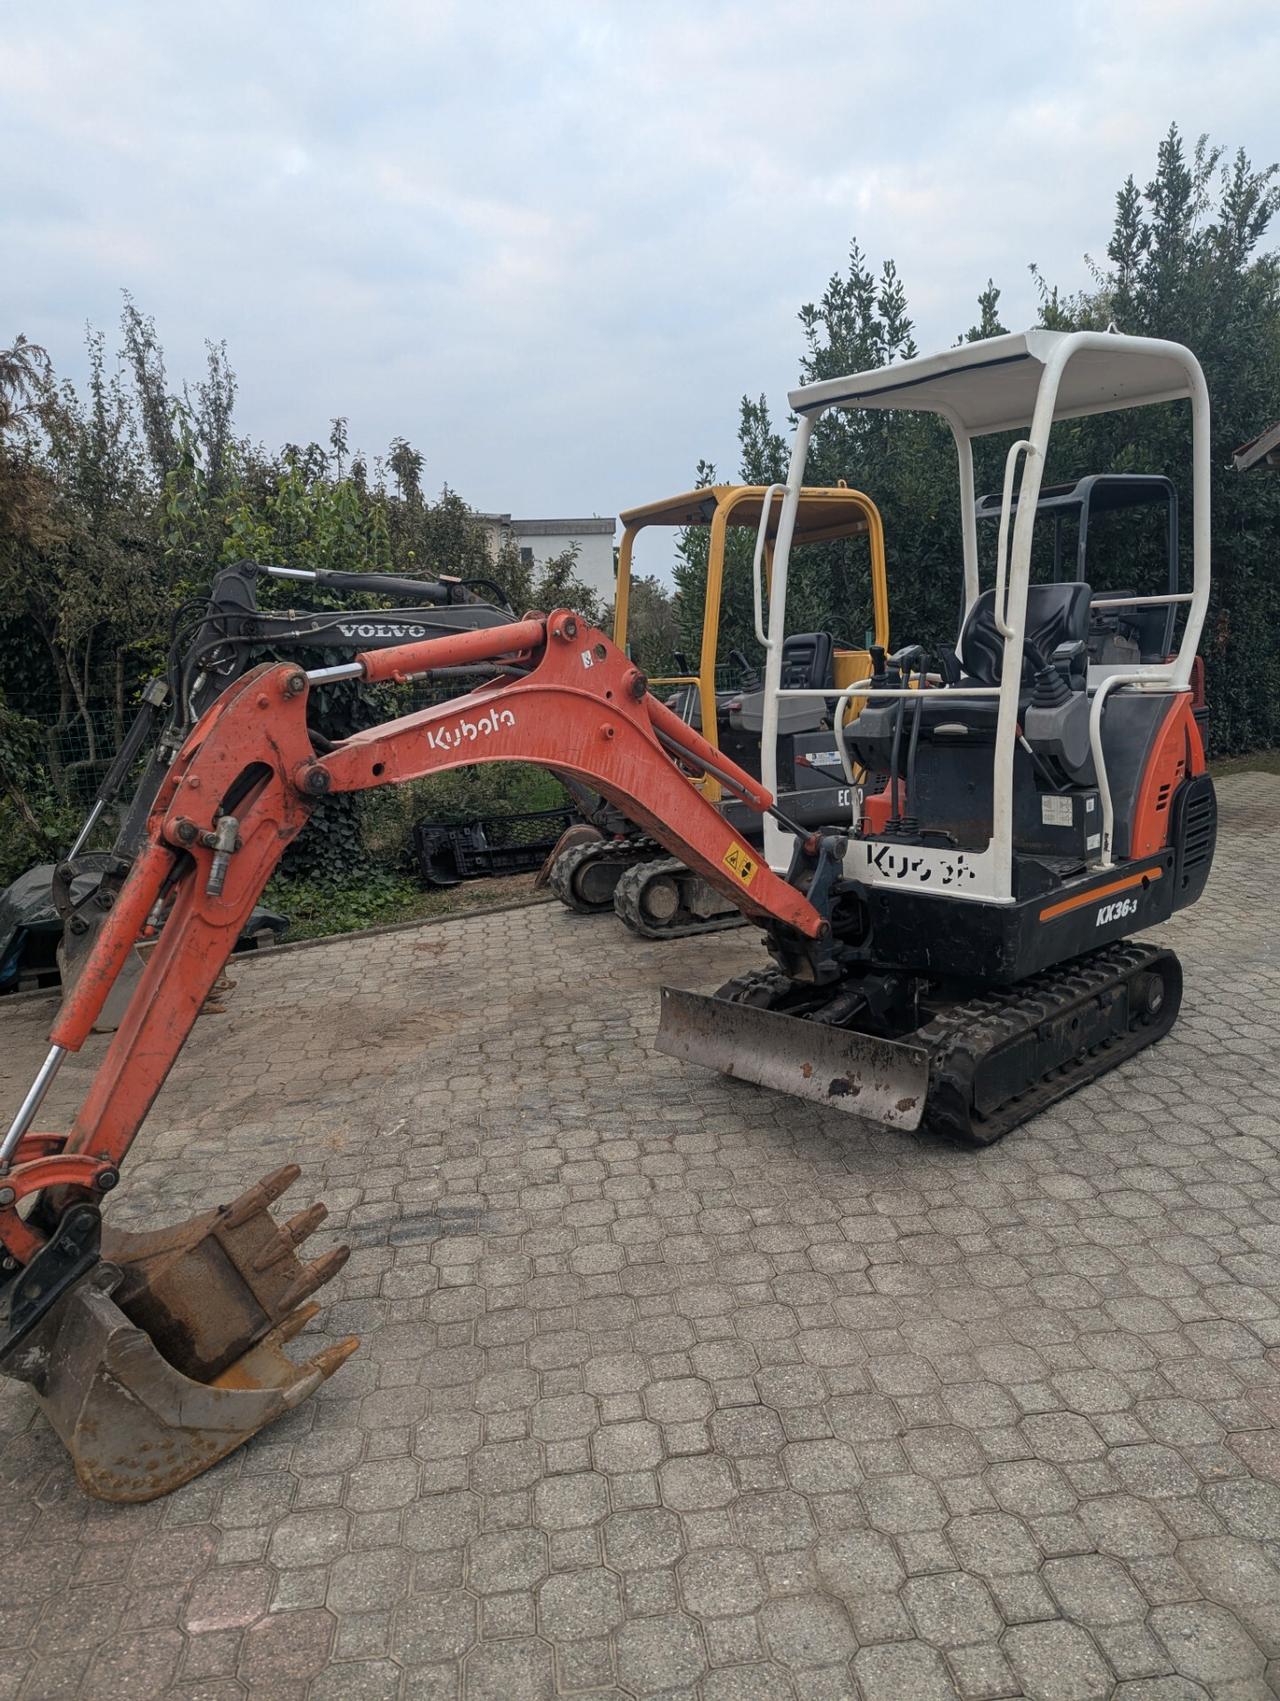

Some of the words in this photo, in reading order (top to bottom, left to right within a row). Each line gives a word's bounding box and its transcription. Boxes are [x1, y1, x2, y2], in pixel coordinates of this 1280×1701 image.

[336, 624, 426, 638] VOLVO
[427, 708, 516, 750] Kubota
[838, 788, 864, 807] EC0
[1096, 898, 1138, 927] KX36-3
